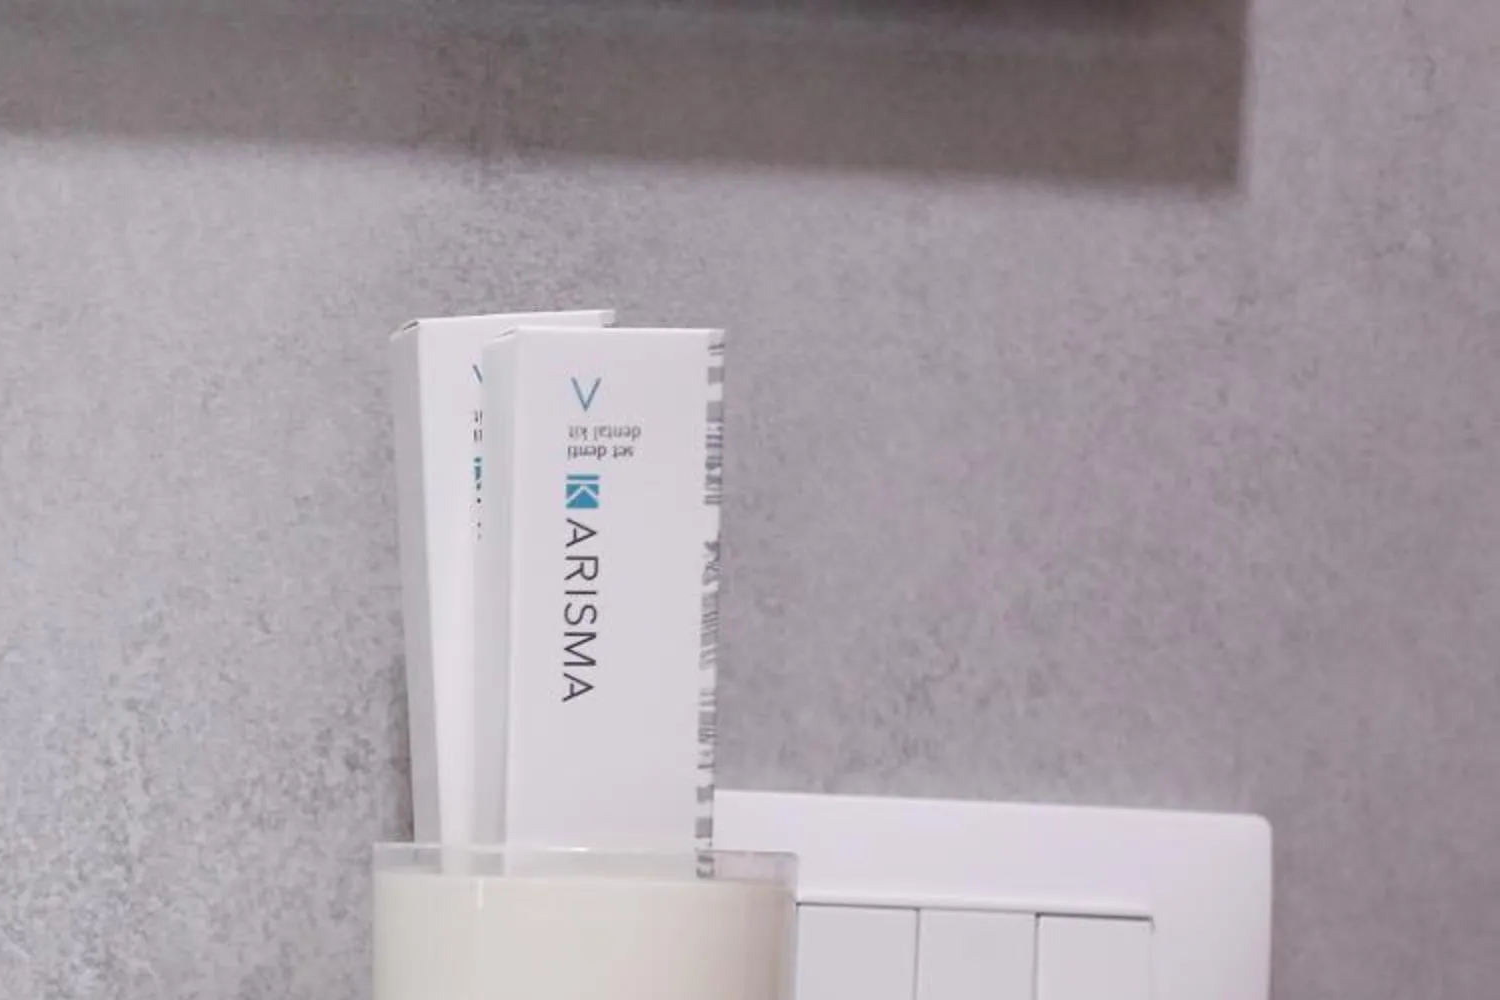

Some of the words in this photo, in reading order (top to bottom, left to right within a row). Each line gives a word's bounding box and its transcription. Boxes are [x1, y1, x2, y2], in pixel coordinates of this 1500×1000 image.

[567, 425, 589, 441] kit
[594, 425, 642, 441] dental
[567, 445, 608, 460] denti
[612, 445, 635, 459] set
[561, 474, 600, 702] KARISMA
